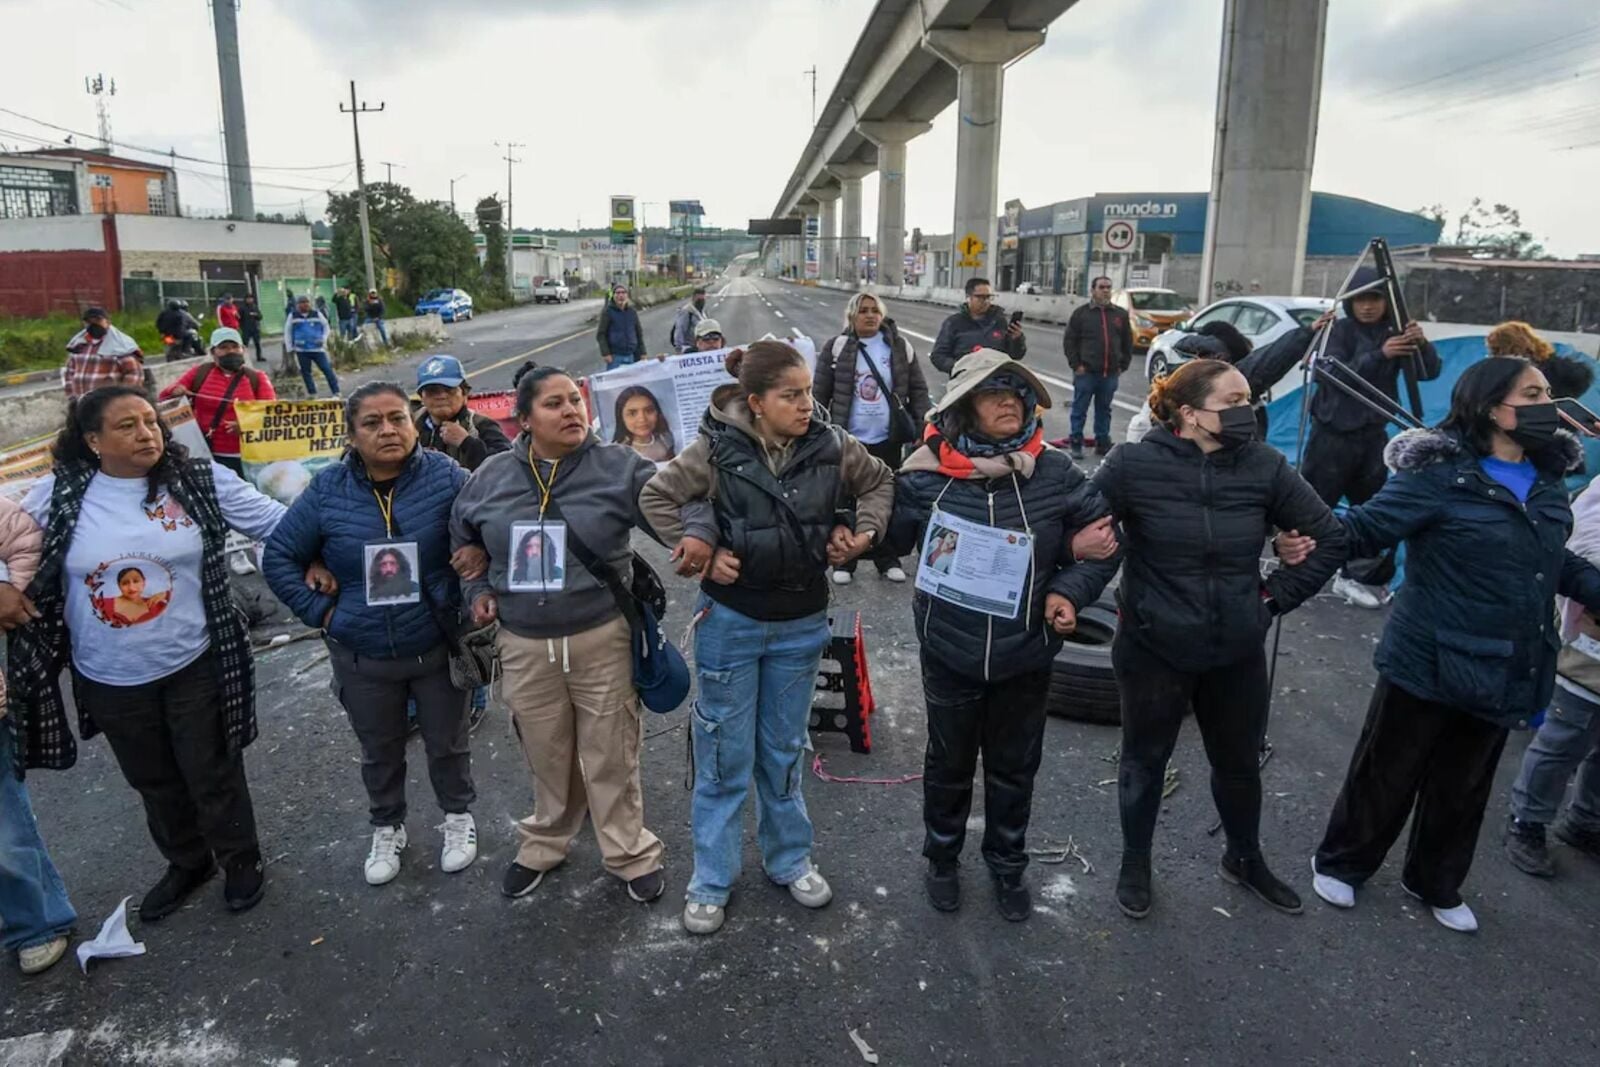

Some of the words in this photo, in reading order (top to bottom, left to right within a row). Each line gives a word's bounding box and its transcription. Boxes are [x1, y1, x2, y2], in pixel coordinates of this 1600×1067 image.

[1104, 201, 1161, 215] mundo
[263, 412, 336, 428] BUSQUEDA
[319, 424, 329, 437] Y
